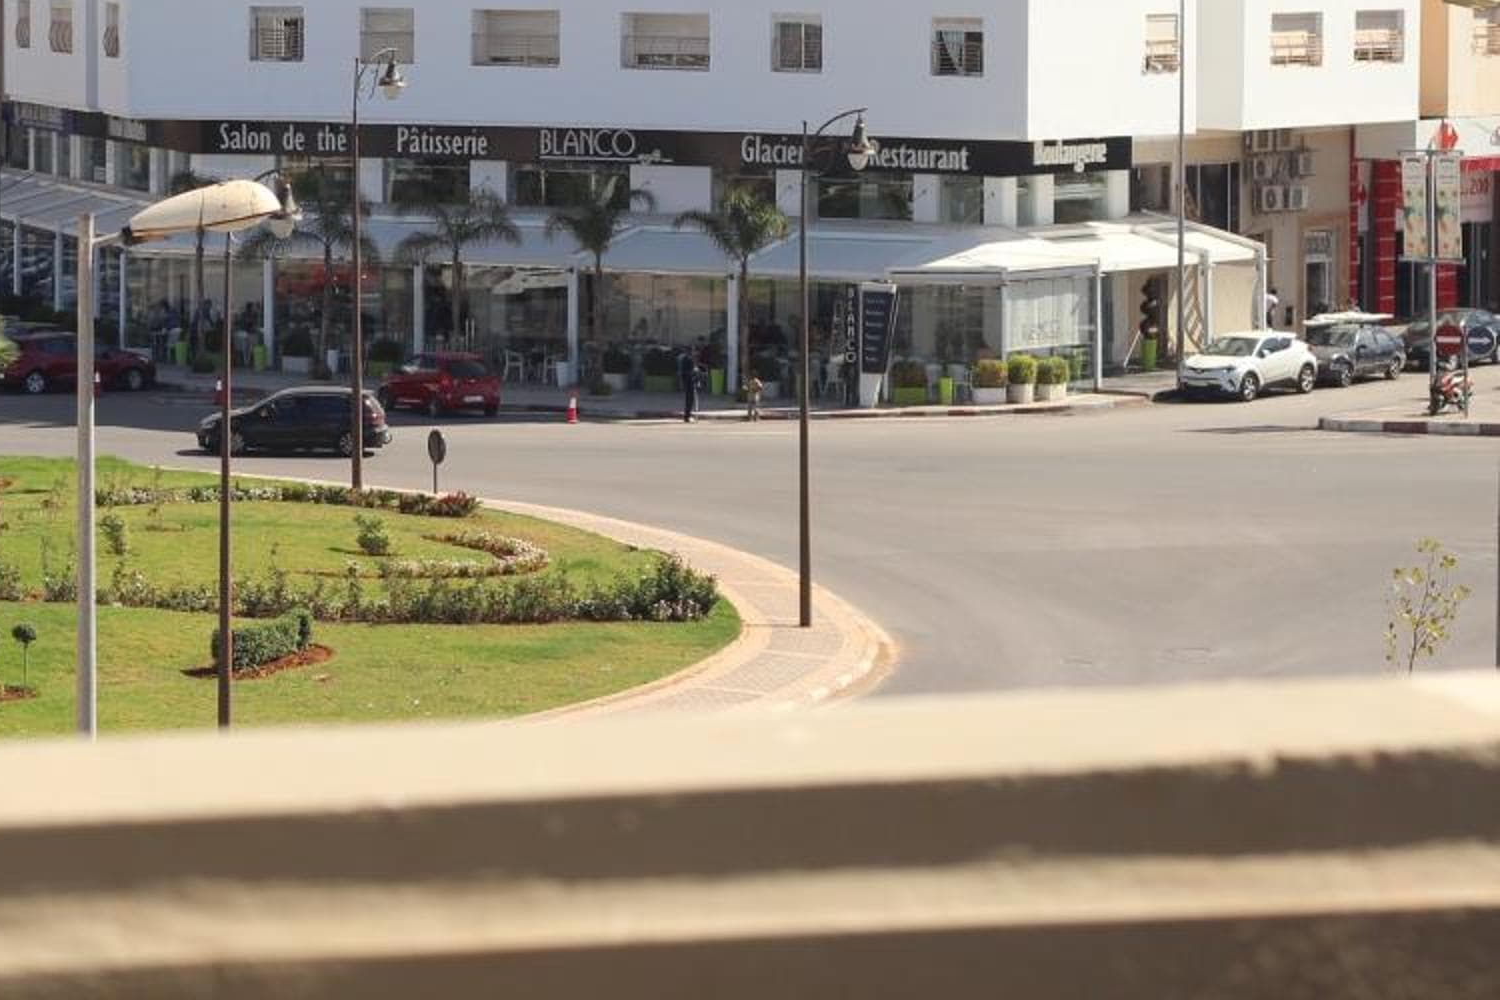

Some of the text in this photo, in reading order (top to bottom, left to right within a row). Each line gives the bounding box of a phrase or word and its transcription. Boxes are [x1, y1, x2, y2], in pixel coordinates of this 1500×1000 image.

[219, 123, 271, 151] Salon
[283, 123, 305, 150] de
[396, 127, 489, 155] Pâtisserie
[539, 129, 636, 156] BLANCO
